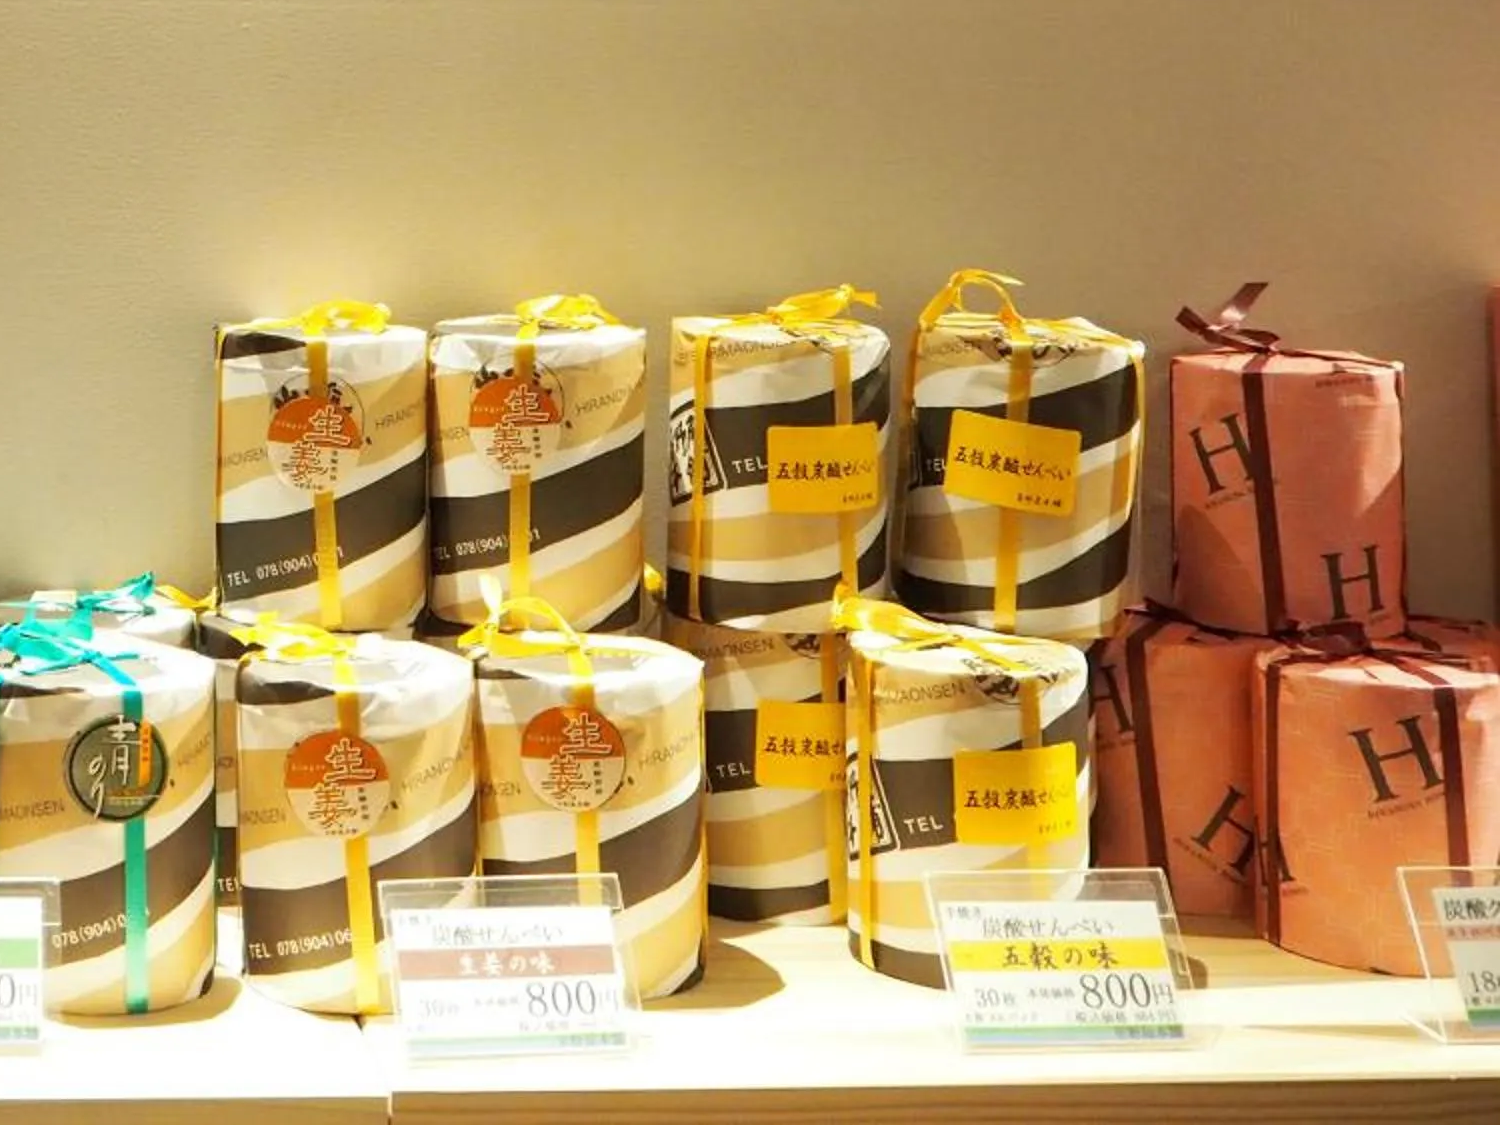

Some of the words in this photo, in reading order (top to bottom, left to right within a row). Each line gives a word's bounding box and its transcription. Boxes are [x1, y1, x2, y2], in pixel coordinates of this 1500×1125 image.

[281, 404, 351, 482] 生姜
[486, 383, 550, 464] 生姜
[731, 455, 769, 475] TEL
[1189, 413, 1255, 495] H
[227, 570, 250, 588] TEL
[1320, 544, 1386, 622] H
[308, 737, 377, 829] 生姜
[541, 712, 613, 801] 生姜
[715, 762, 752, 778] TEL
[1347, 714, 1446, 803] H
[903, 814, 944, 836] TEL
[248, 941, 271, 960] TEL
[982, 915, 1117, 940] 炭酸せんべい
[1002, 940, 1119, 972] 五穀の味
